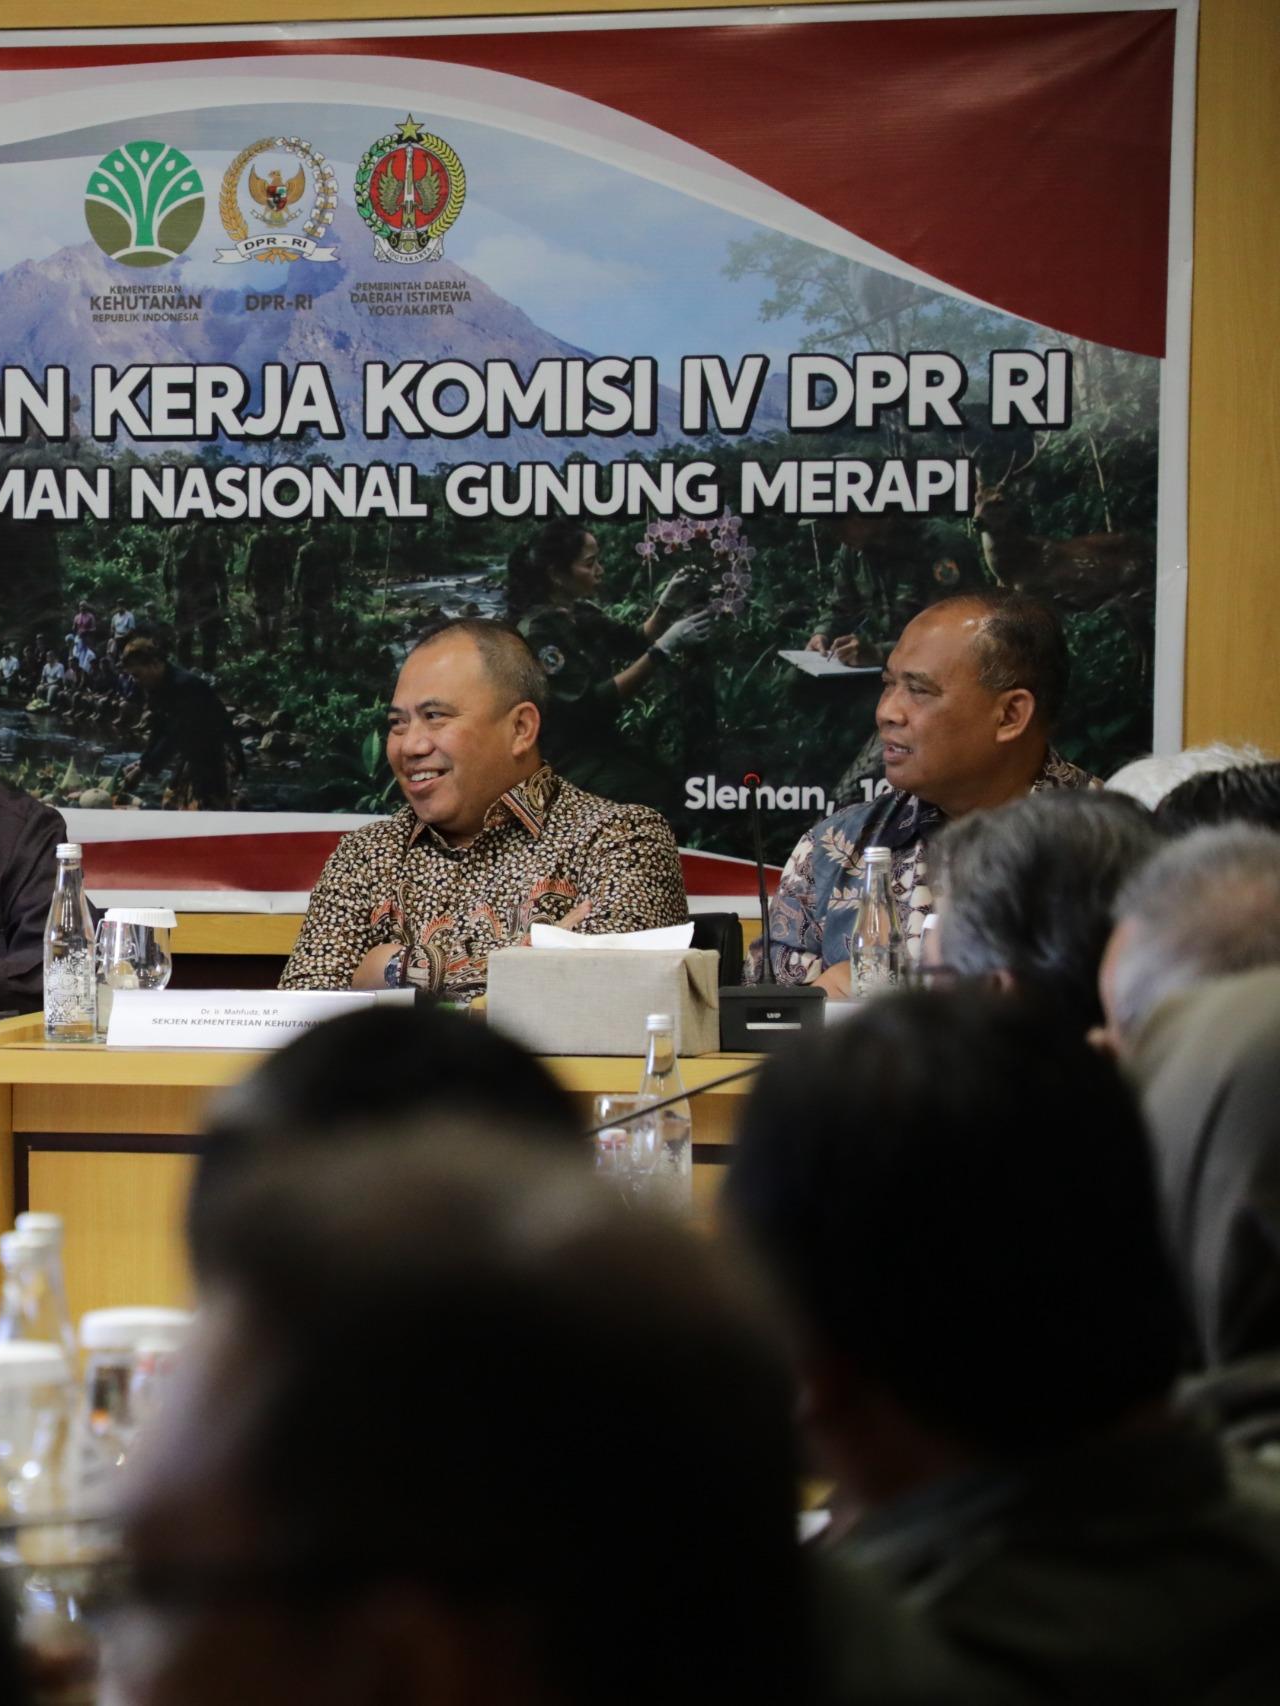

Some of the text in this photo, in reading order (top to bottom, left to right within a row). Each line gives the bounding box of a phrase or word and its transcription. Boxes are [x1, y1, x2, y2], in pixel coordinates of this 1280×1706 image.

[243, 237, 278, 252] DPR
[291, 237, 308, 249] RI
[109, 285, 182, 295] KEMENTERIAN
[356, 281, 467, 291] PEMERINTAH DAERAH
[90, 295, 202, 311] KEHUTANAN
[245, 295, 314, 311] DPR-RI
[350, 291, 472, 304] DAERAH ISTIMEWA
[368, 304, 454, 316] YOGYAKARTA
[92, 313, 199, 323] REPUBLIK INDONESIA
[92, 364, 342, 438] KERJA
[365, 358, 653, 436] KOMISI
[681, 356, 767, 432] IV
[790, 352, 965, 430] DPR
[991, 350, 1070, 427] RI
[130, 464, 428, 519] NASIONAL
[444, 460, 719, 517] GUNUNG
[740, 458, 970, 513] MERAPI
[151, 1018, 188, 1026] SEKJEN
[190, 1018, 262, 1027] KEMENTERIAN
